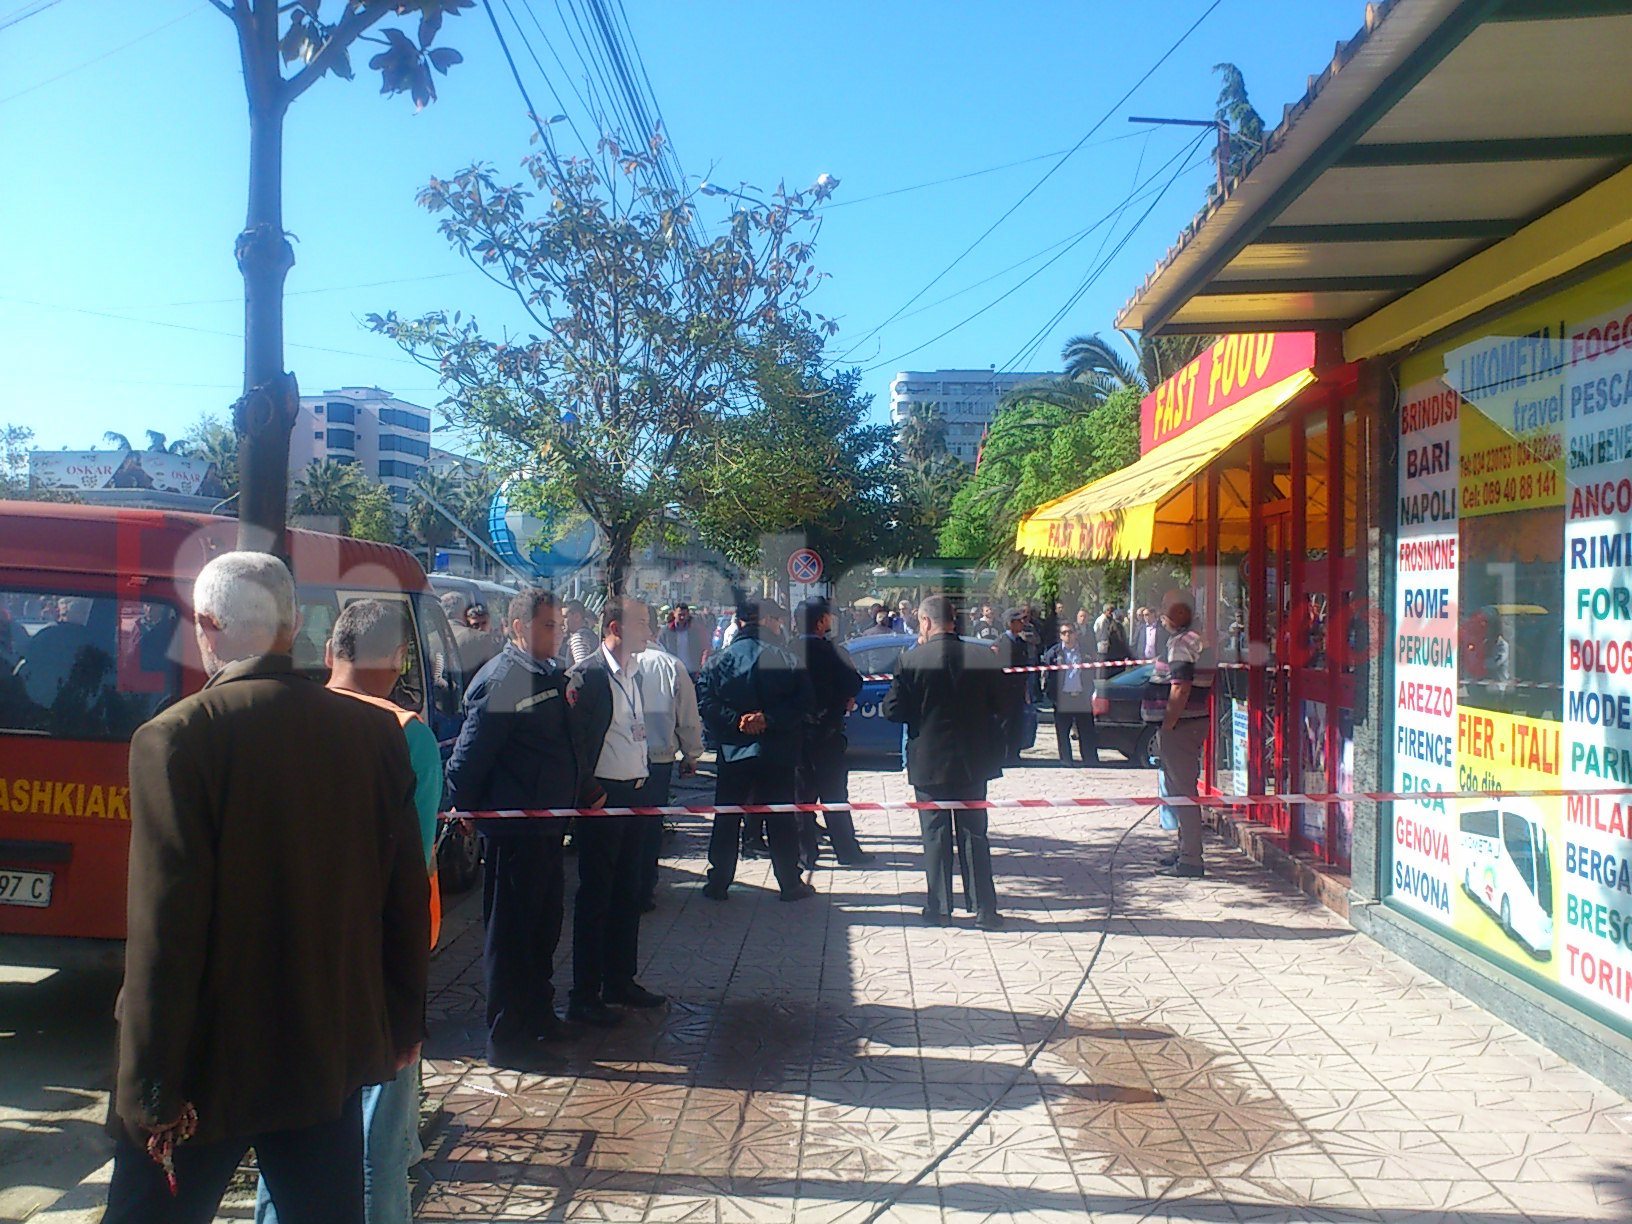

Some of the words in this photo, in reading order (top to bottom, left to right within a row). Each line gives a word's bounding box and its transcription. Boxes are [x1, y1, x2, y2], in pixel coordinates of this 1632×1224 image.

[1571, 313, 1632, 367] FOGG
[1460, 320, 1565, 404] LIKOMETAJ
[1153, 358, 1201, 441] FAST
[1207, 331, 1275, 406] FOOD
[1570, 369, 1632, 419] PESCA
[1401, 389, 1458, 435] BRINDISI
[1513, 384, 1564, 433] travel
[66, 465, 112, 475] OSKAR
[1406, 440, 1450, 480] BARI
[1570, 432, 1594, 469] SAN
[1400, 487, 1456, 526] NAPOLI
[1463, 484, 1480, 508] Cel:
[1504, 476, 1516, 502] 40
[1537, 469, 1556, 498] 141
[1570, 478, 1632, 519] ANCO
[1048, 522, 1074, 549] FAST
[1399, 538, 1455, 572] FROSINONE
[1404, 587, 1449, 618] ROME
[1577, 587, 1631, 621] FOR
[1399, 634, 1453, 669] PERUGIA
[1570, 639, 1632, 675] BOLOG
[1398, 680, 1453, 718] AREZZO
[1569, 690, 1631, 729] MODE
[1397, 725, 1452, 768] FIRENCE
[1458, 713, 1494, 760] FIER
[1511, 722, 1560, 776] ITALI
[1402, 772, 1446, 815] PISA
[1396, 816, 1451, 866] GENOVA
[31, 877, 44, 899] C
[1395, 859, 1451, 915] SAVONA
[1566, 841, 1632, 895] BERGA
